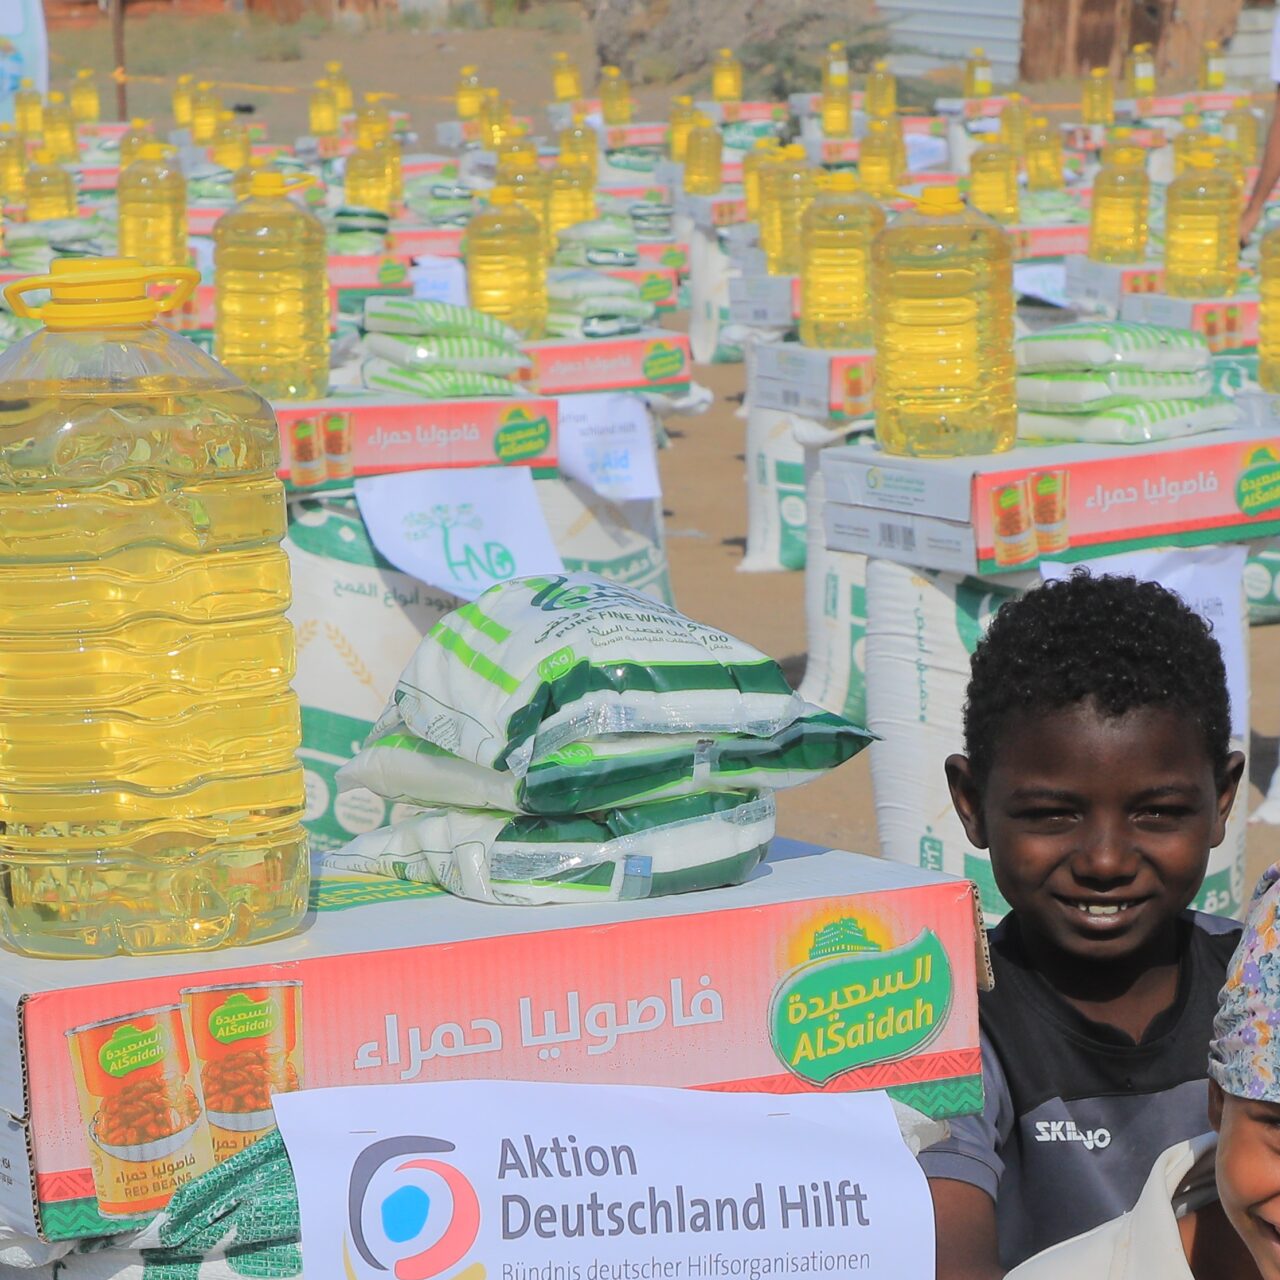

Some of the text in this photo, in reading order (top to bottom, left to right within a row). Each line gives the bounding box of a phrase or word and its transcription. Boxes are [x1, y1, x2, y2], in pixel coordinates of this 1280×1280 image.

[367, 424, 480, 449] فاصوليا حمراء
[1085, 471, 1219, 512] فاصوليا حمراء
[555, 614, 597, 638] PURE
[599, 611, 635, 623] FINE
[787, 953, 935, 1026] السعيدة
[215, 1006, 273, 1027] السعيدة
[215, 1018, 273, 1039] AlSaidah
[353, 974, 726, 1081] فاصوليا حمراء
[106, 1031, 163, 1060] السعيدة
[791, 998, 935, 1067] AlSaidah
[109, 1045, 164, 1073] AlSaidah
[152, 1155, 196, 1176] فاصوليا
[497, 1134, 638, 1179] Aktion
[115, 1169, 147, 1185] حمراء
[124, 1172, 193, 1199] RED BEANS
[501, 1179, 871, 1240] Deutschland Hilft
